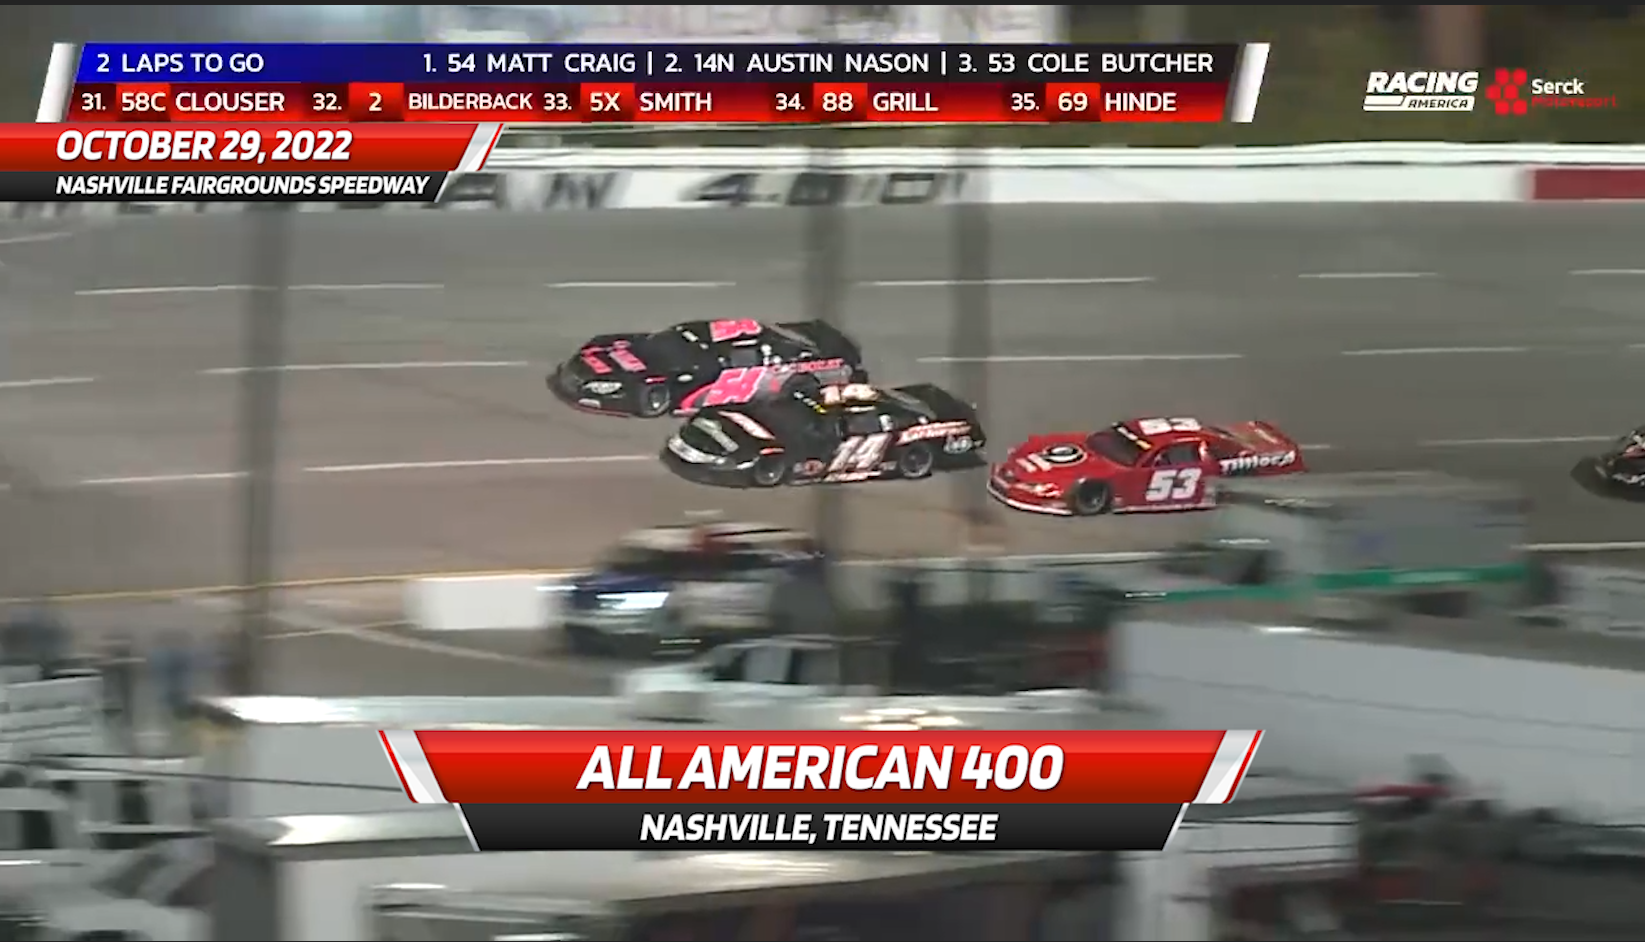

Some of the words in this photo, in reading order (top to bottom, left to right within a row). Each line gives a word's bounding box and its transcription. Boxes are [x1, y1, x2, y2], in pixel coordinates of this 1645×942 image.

[702, 366, 767, 406] 54
[827, 432, 893, 472] 14
[1145, 467, 1203, 501] 53
